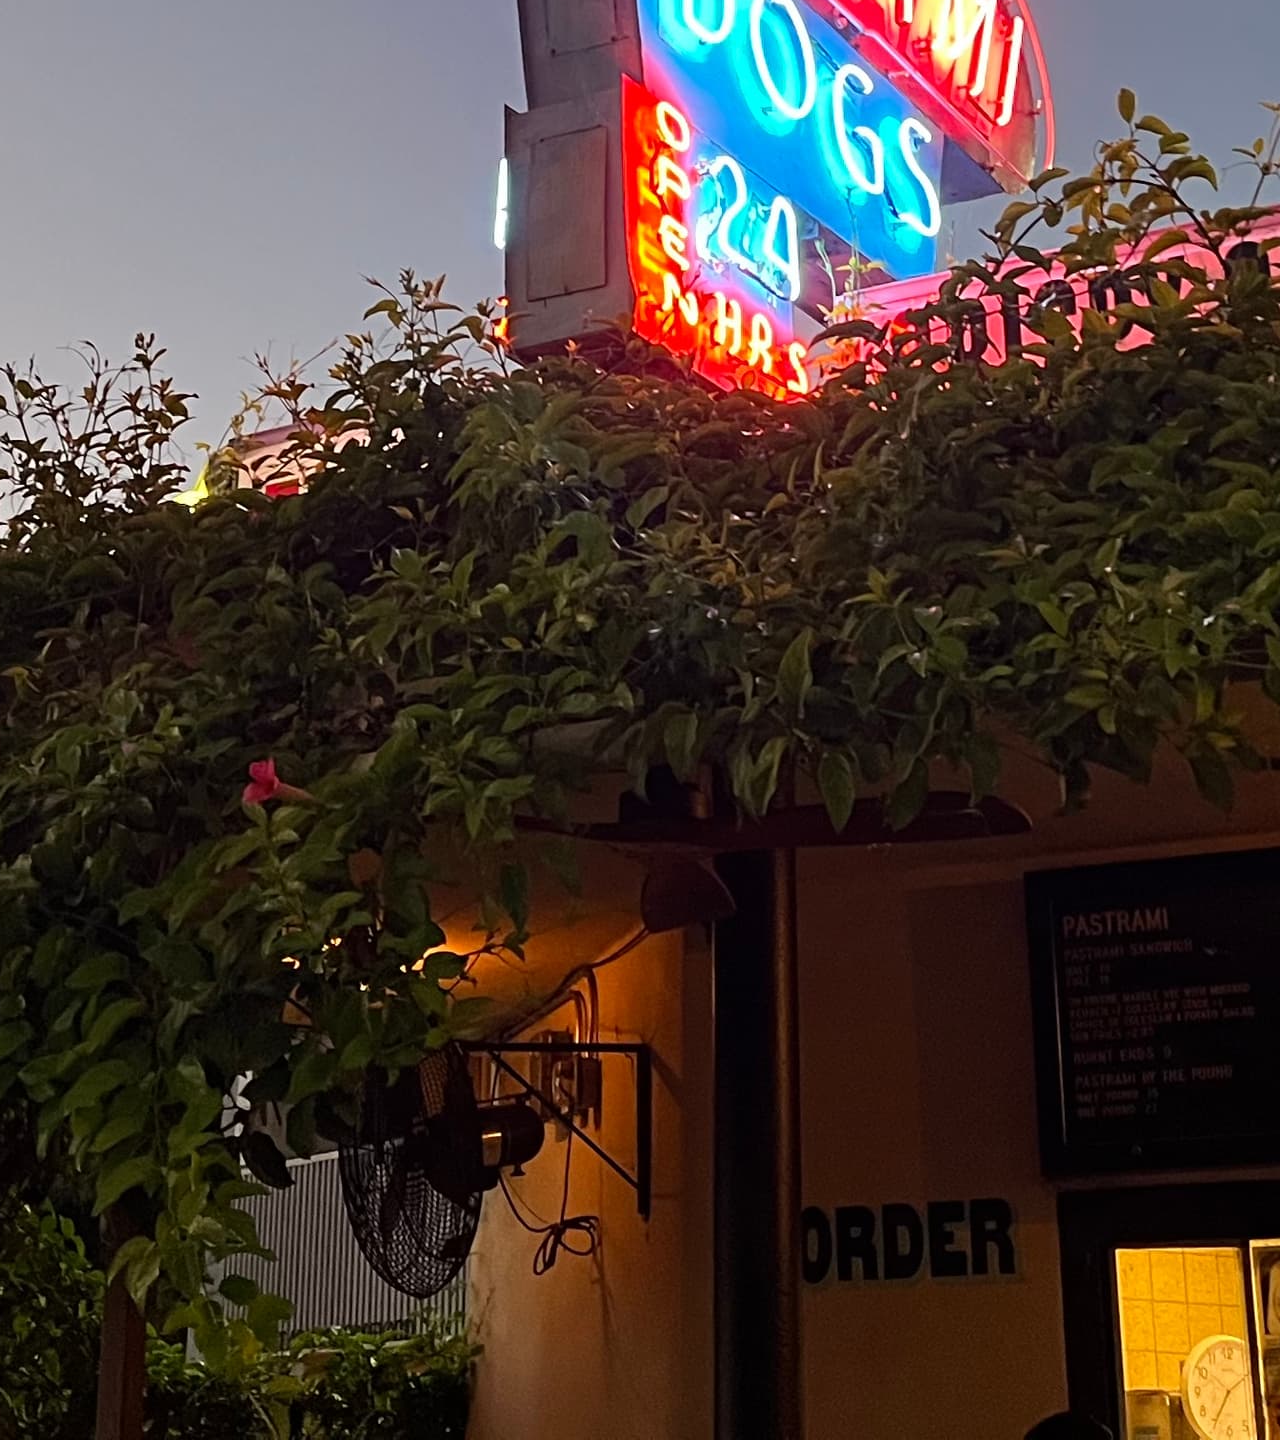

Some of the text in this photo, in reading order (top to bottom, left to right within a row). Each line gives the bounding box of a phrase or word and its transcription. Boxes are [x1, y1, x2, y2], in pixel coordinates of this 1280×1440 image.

[654, 100, 699, 328] OPEN
[708, 291, 811, 395] HRS
[1062, 905, 1170, 939] PASTRAMI
[800, 1198, 1016, 1285] ORDER
